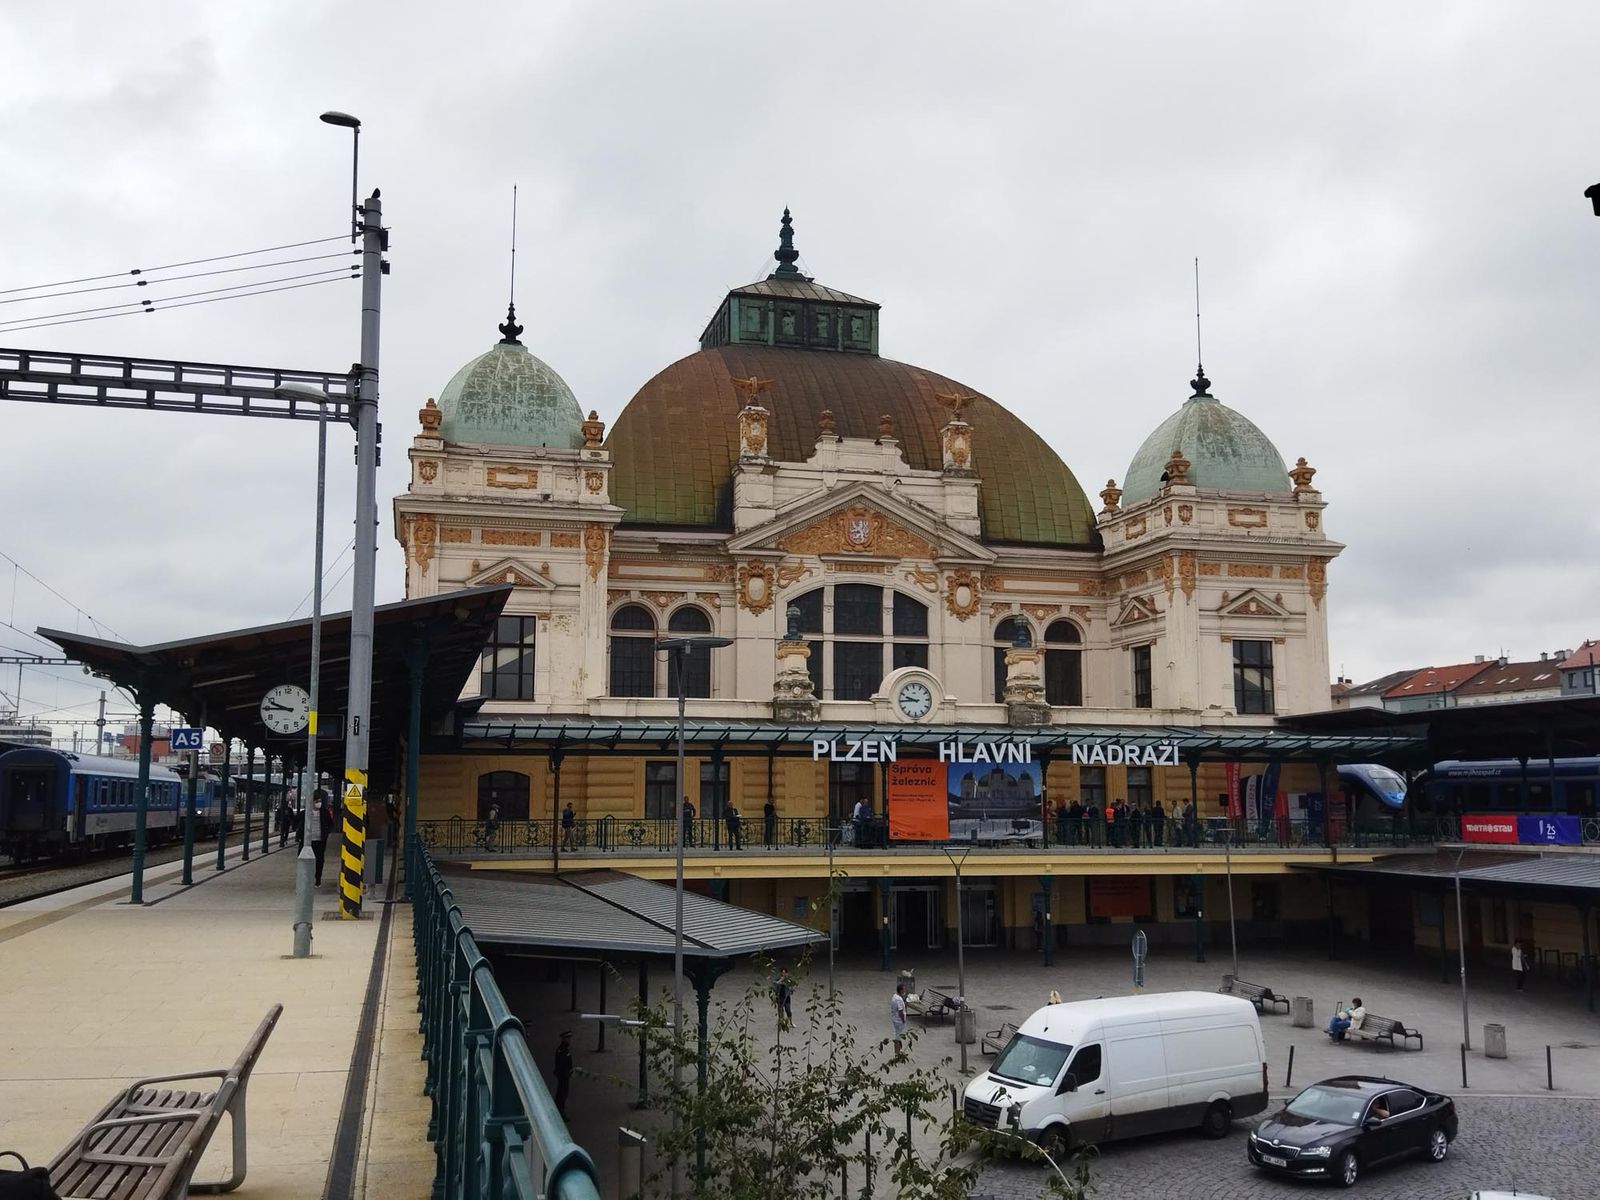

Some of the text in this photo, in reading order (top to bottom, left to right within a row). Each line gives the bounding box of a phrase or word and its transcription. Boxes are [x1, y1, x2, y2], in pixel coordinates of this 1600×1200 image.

[813, 735, 1179, 766] PLZEŇ HLAVNÍ NÁDRAŽÍ
[892, 764, 932, 774] Správa
[892, 776, 936, 786] železnic
